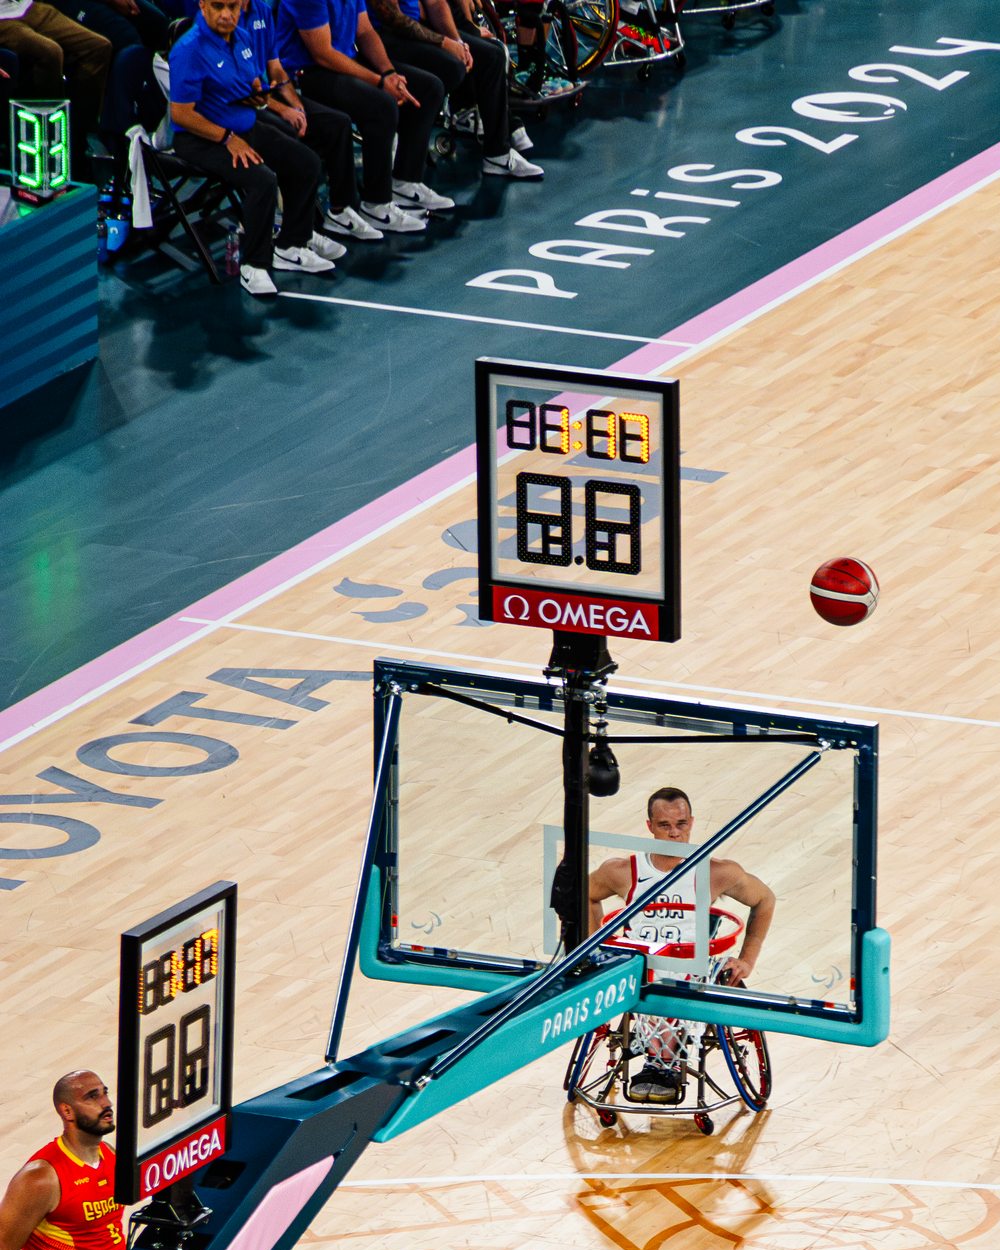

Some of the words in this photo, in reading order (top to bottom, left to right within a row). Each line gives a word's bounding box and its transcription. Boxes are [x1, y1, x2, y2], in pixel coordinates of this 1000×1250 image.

[538, 598, 651, 635] OMEGA
[0, 667, 374, 891] OYOTA
[593, 974, 637, 1016] 2024
[162, 1128, 222, 1182] OMEGA
[82, 1195, 125, 1221] ESPA
